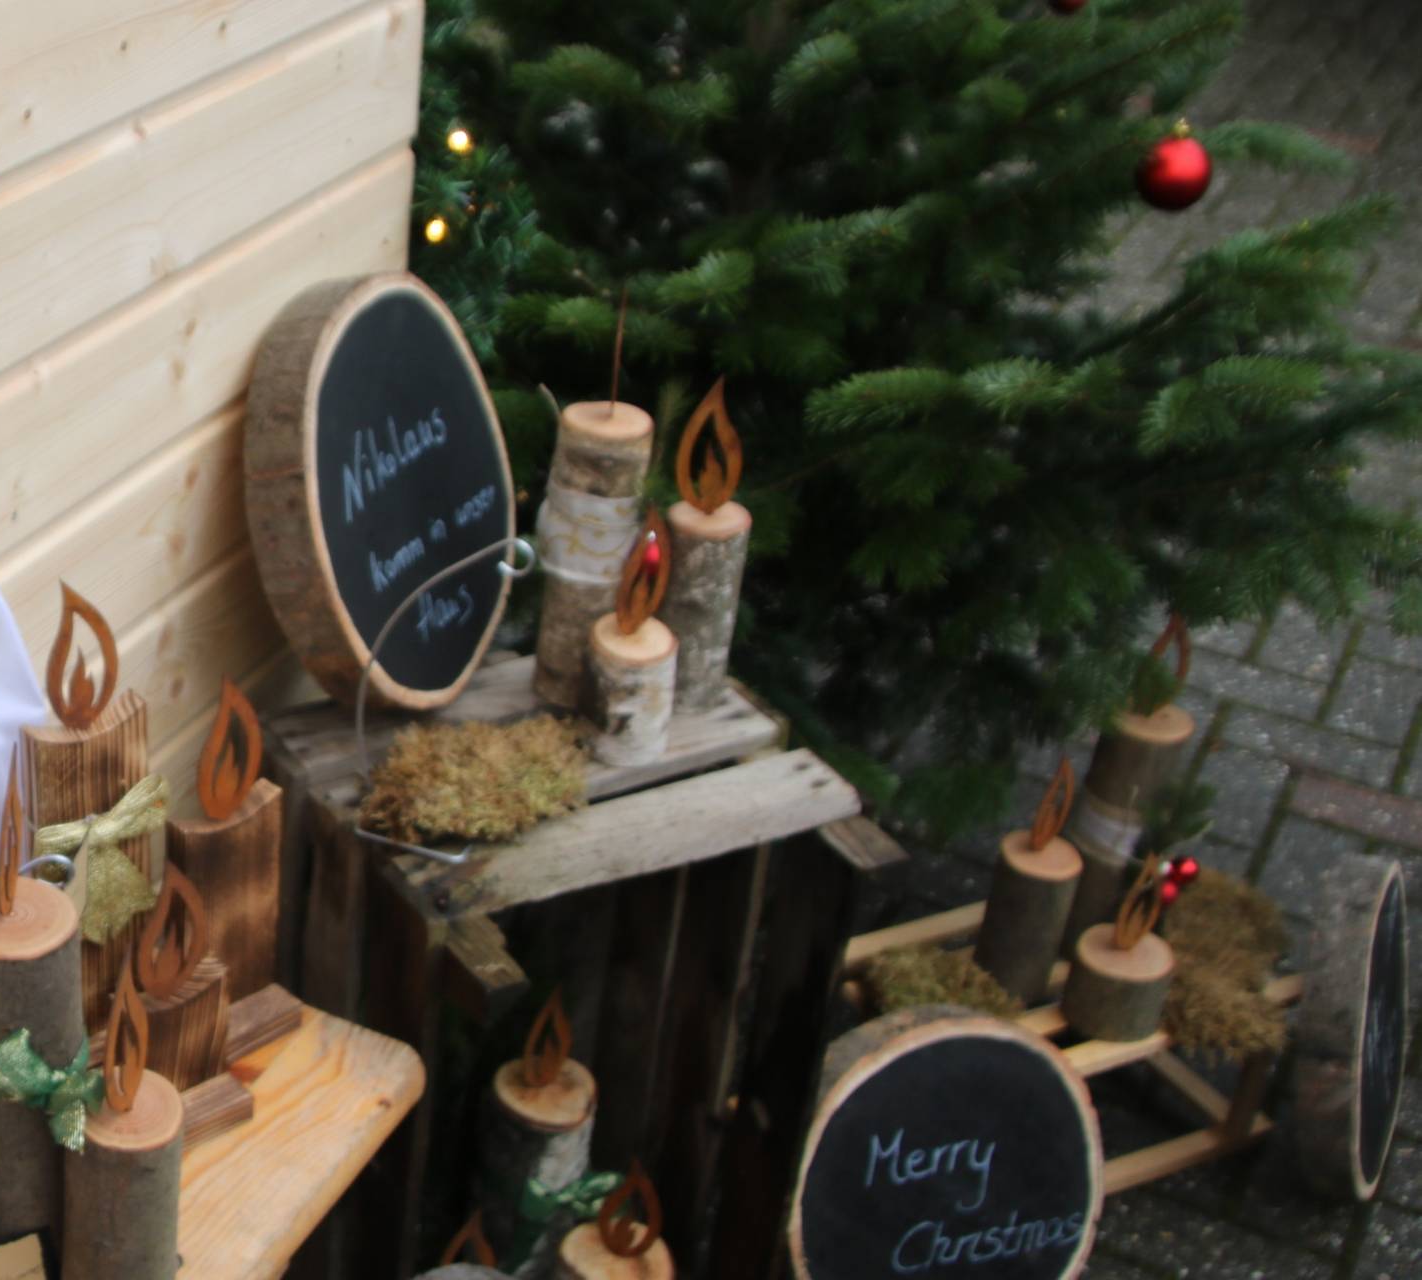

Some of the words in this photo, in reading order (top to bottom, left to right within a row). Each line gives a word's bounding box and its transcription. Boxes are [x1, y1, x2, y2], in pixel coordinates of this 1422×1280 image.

[342, 406, 447, 524] Nikolaus
[864, 1127, 996, 1213] Merry
[891, 1208, 1086, 1274] Christmas
